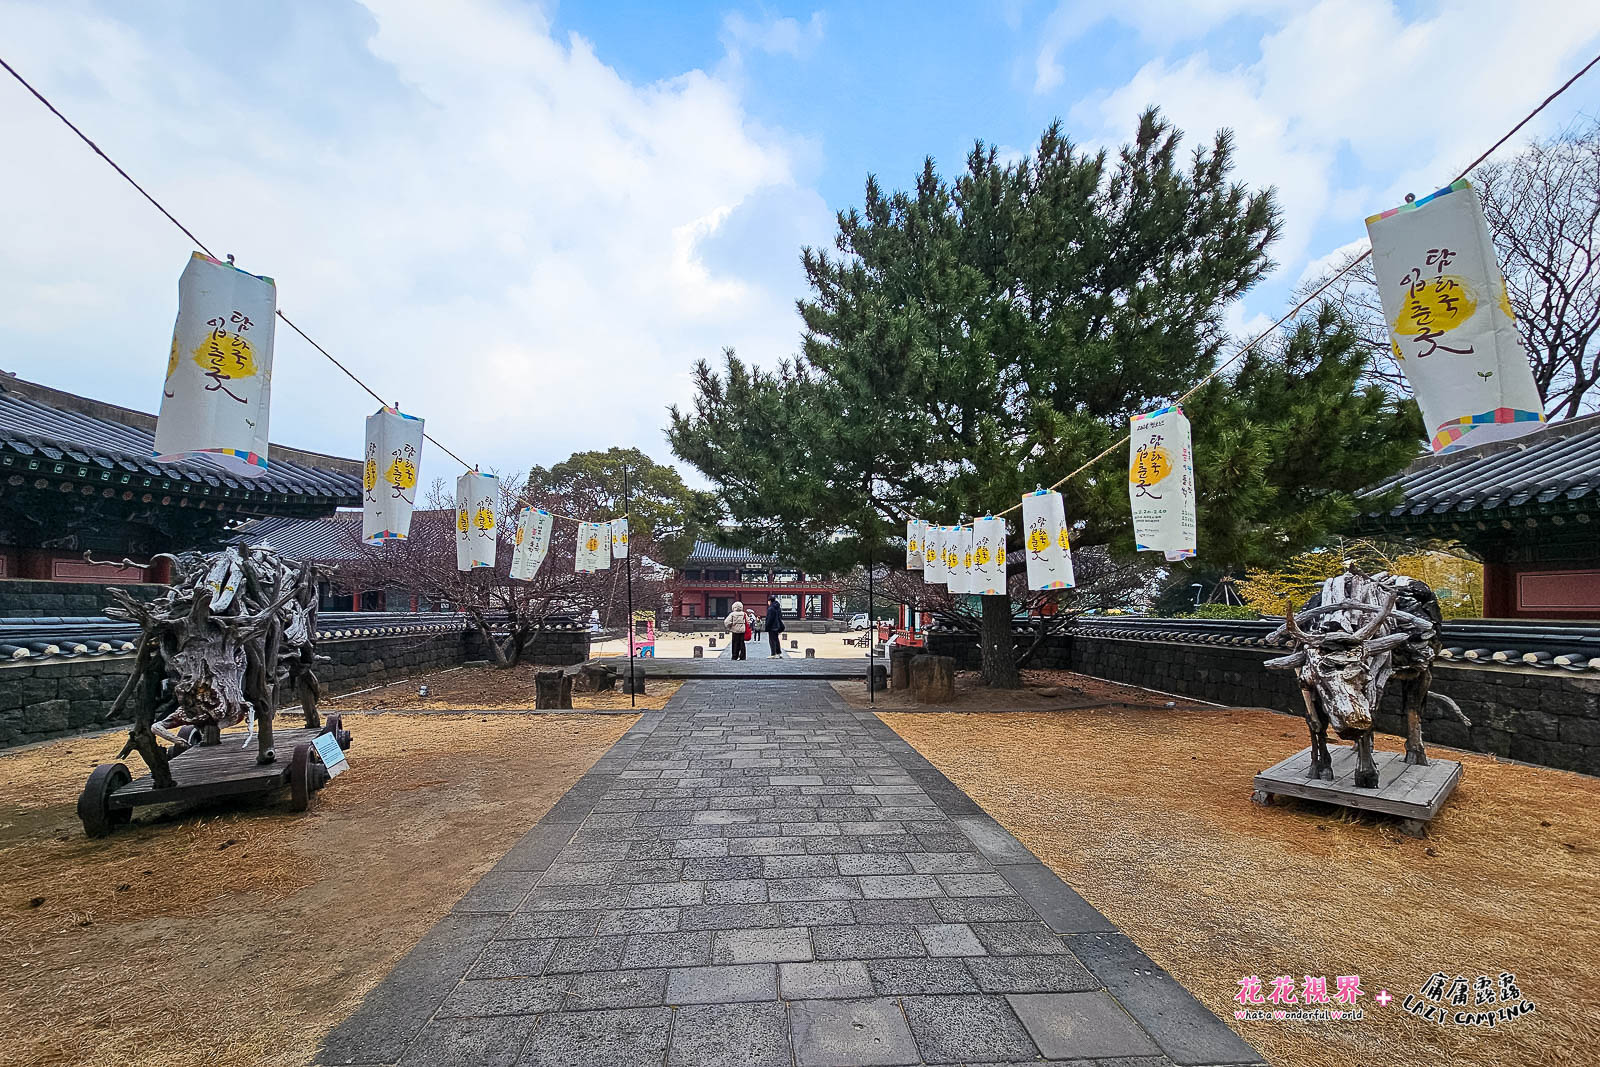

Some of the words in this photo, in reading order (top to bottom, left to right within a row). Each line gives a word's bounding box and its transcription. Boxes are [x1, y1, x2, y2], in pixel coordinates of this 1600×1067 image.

[1426, 248, 1459, 319] 탐라국
[231, 310, 254, 370] 탐라국
[1399, 267, 1475, 359] 입춘굿
[204, 316, 248, 404] 입춘굿
[391, 449, 414, 505] 입춘굿
[404, 443, 417, 483] 탐라국
[1135, 443, 1162, 500] 입춘굿
[1149, 434, 1164, 477] 탐라국
